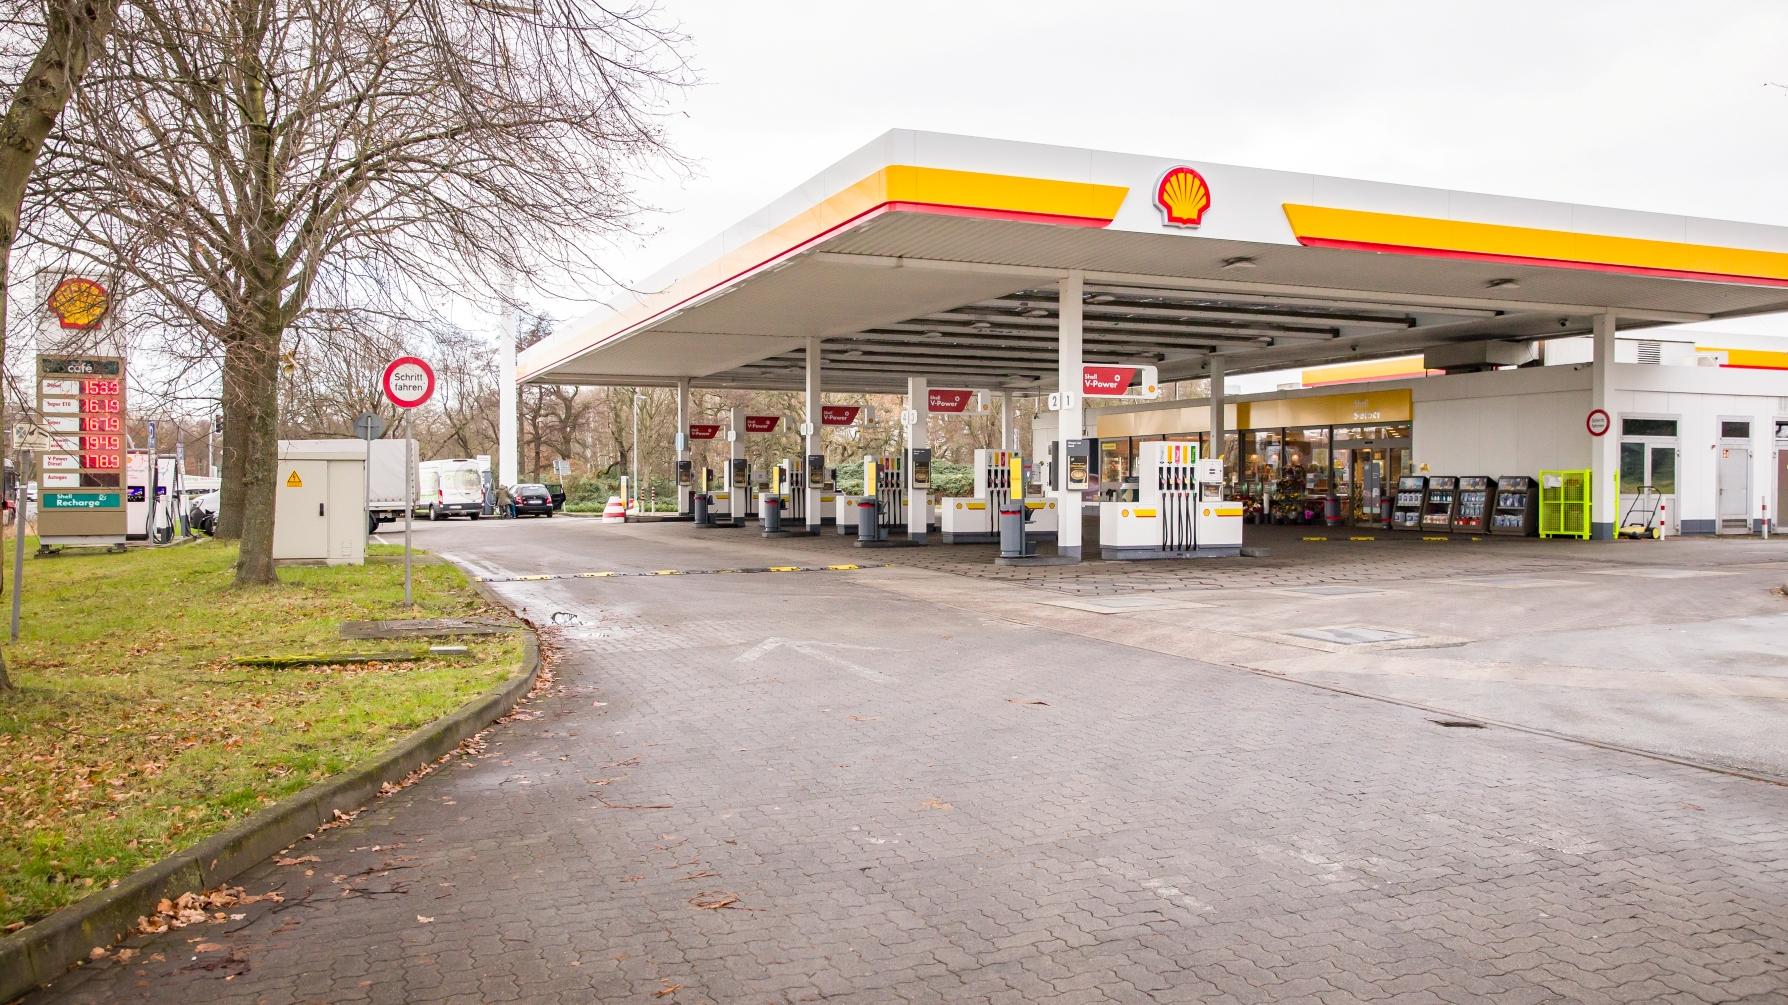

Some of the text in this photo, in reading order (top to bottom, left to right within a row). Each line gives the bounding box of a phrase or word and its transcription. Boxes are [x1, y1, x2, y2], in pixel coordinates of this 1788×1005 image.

[67, 362, 93, 373] café
[394, 372, 423, 381] Schritt
[394, 383, 423, 392] fahren
[1084, 380, 1118, 388] V-Power
[1052, 395, 1057, 407] 2
[56, 499, 100, 508] Recharge
